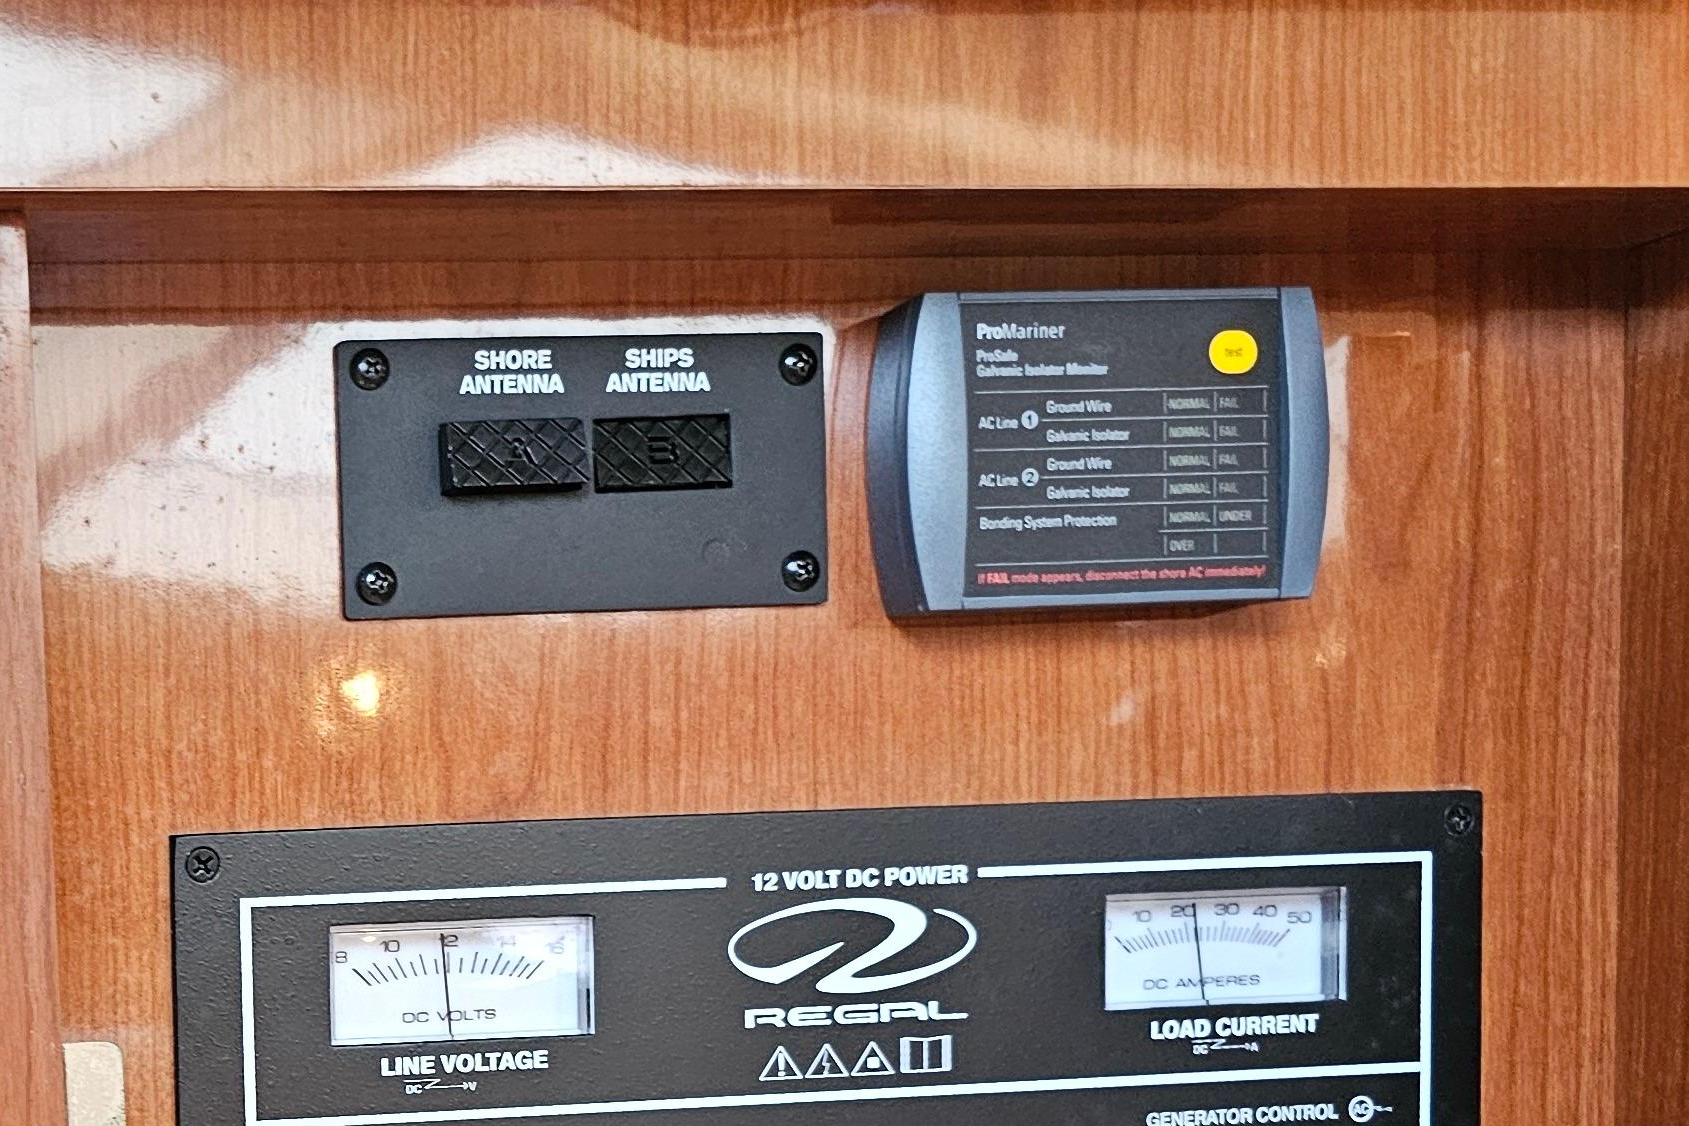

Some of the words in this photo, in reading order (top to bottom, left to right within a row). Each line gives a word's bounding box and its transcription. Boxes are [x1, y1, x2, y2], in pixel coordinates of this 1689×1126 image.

[976, 322, 1066, 340] ProMariner
[474, 350, 552, 371] SHORE
[625, 348, 695, 369] SHIPS
[459, 373, 564, 395] ANTENNA
[606, 371, 711, 393] ANTENNA
[1046, 400, 1084, 413] Ground
[1085, 400, 1112, 413] Wire
[978, 416, 995, 430] AC
[996, 416, 1019, 429] Line
[1046, 458, 1084, 471] Ground
[1085, 457, 1112, 470] Wire
[1169, 454, 1210, 466] NORMAL
[978, 474, 995, 487] AC
[996, 474, 1018, 487] Line
[980, 516, 1022, 531] Bonding
[1023, 515, 1062, 530] System
[1063, 514, 1117, 527] Protection
[1219, 510, 1252, 522] UNDER
[1169, 539, 1195, 551] OVER
[751, 872, 779, 892] 12
[782, 870, 842, 891] VOLT
[845, 868, 880, 888] DC
[884, 864, 969, 887] POWER
[1132, 910, 1151, 923] 10
[1214, 903, 1239, 916] 30
[1253, 904, 1278, 917] 40
[1287, 911, 1312, 923] 50
[380, 939, 400, 952] 10
[1143, 978, 1168, 990] DC
[1176, 974, 1261, 987] AMPERES
[402, 1011, 429, 1023] DC
[436, 1008, 496, 1022] VOLTS
[744, 1000, 969, 1029] REGAL
[1150, 1018, 1211, 1040] LOAD
[1215, 1013, 1319, 1037] CURRENT
[380, 1055, 436, 1077] LINE
[439, 1050, 549, 1074] VOLTAGE
[1256, 1103, 1339, 1125] CONTROL
